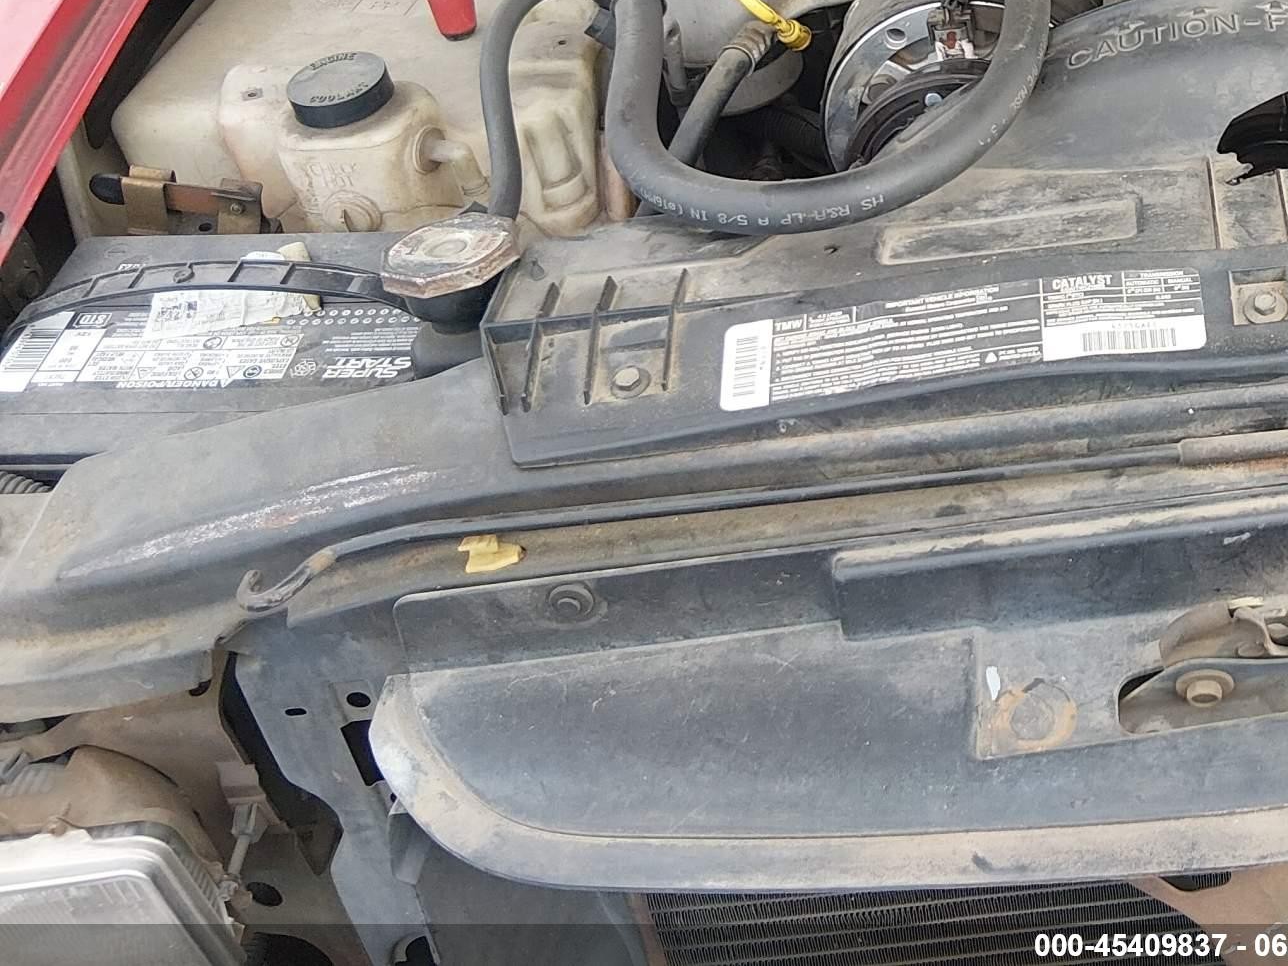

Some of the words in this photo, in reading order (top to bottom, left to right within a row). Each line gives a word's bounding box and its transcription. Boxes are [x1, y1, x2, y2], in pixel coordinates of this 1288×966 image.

[690, 206, 708, 221] IN
[718, 213, 748, 226] 5/8
[1052, 274, 1113, 292] CATALYST
[79, 314, 107, 325] STD
[774, 319, 803, 332] TMW
[325, 356, 412, 368] START
[321, 366, 400, 379] SUPER
